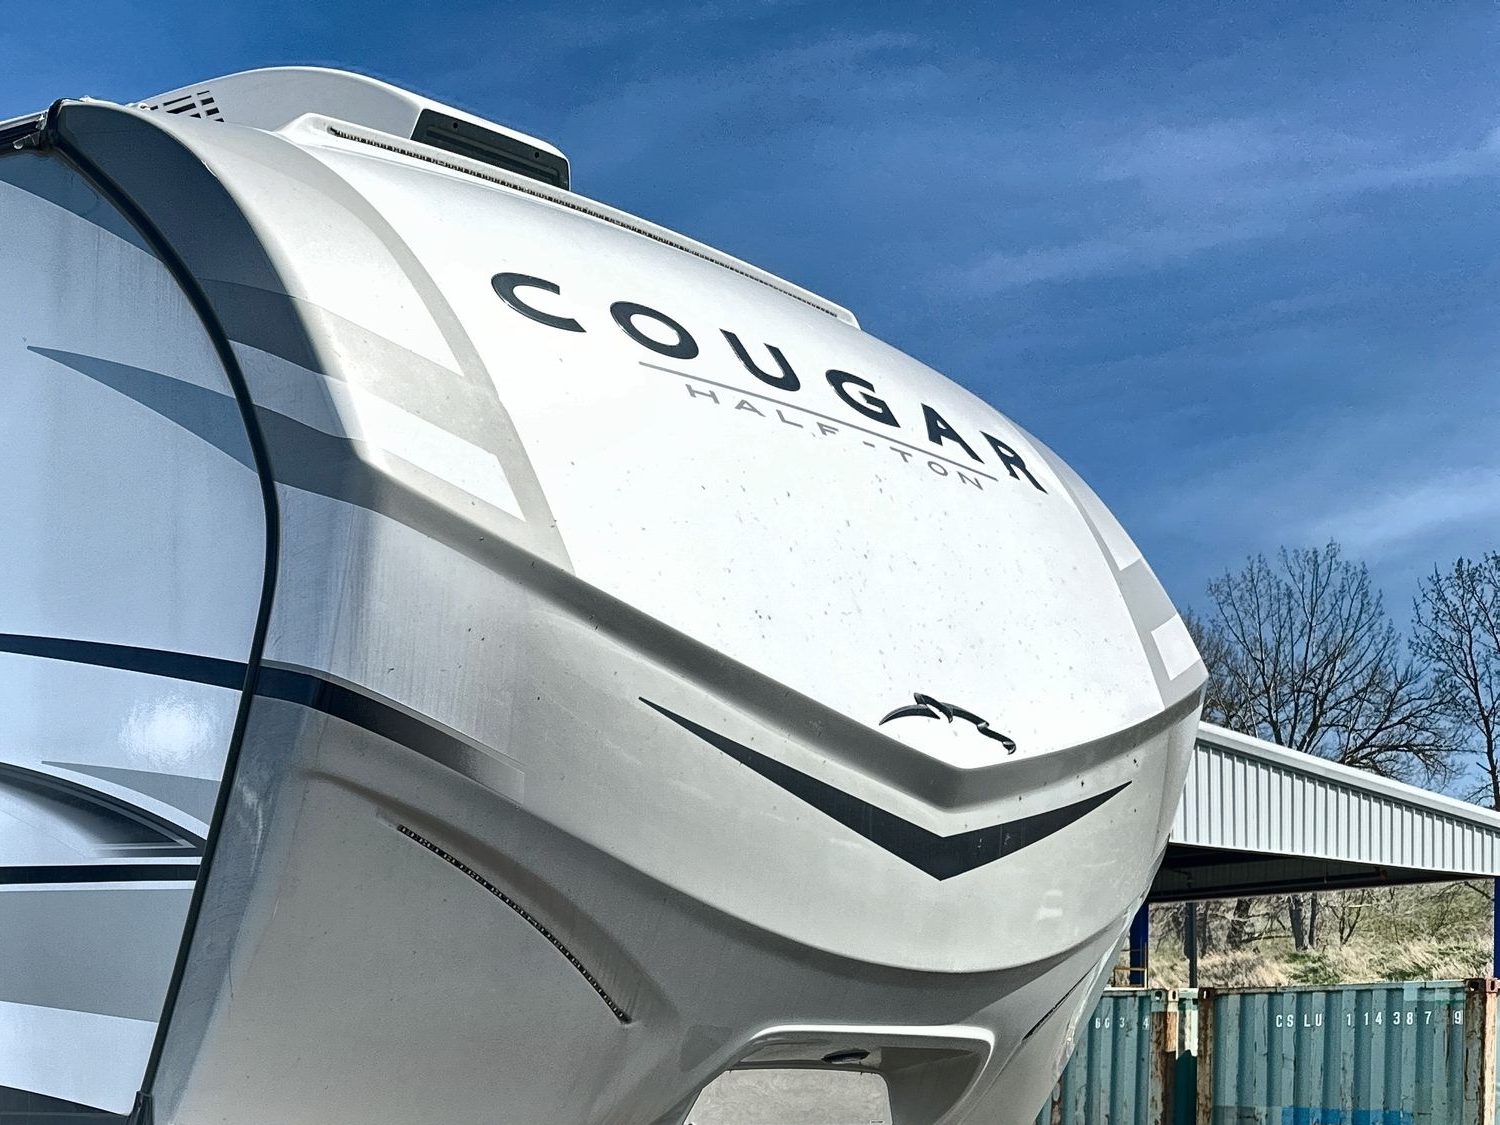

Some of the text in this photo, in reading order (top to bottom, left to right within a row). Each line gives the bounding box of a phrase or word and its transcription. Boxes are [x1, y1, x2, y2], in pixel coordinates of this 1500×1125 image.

[490, 271, 1049, 495] COUGAR
[686, 382, 985, 491] HALF-TON
[1276, 1013, 1323, 1028] CSLU
[1347, 1011, 1432, 1026] 114387
